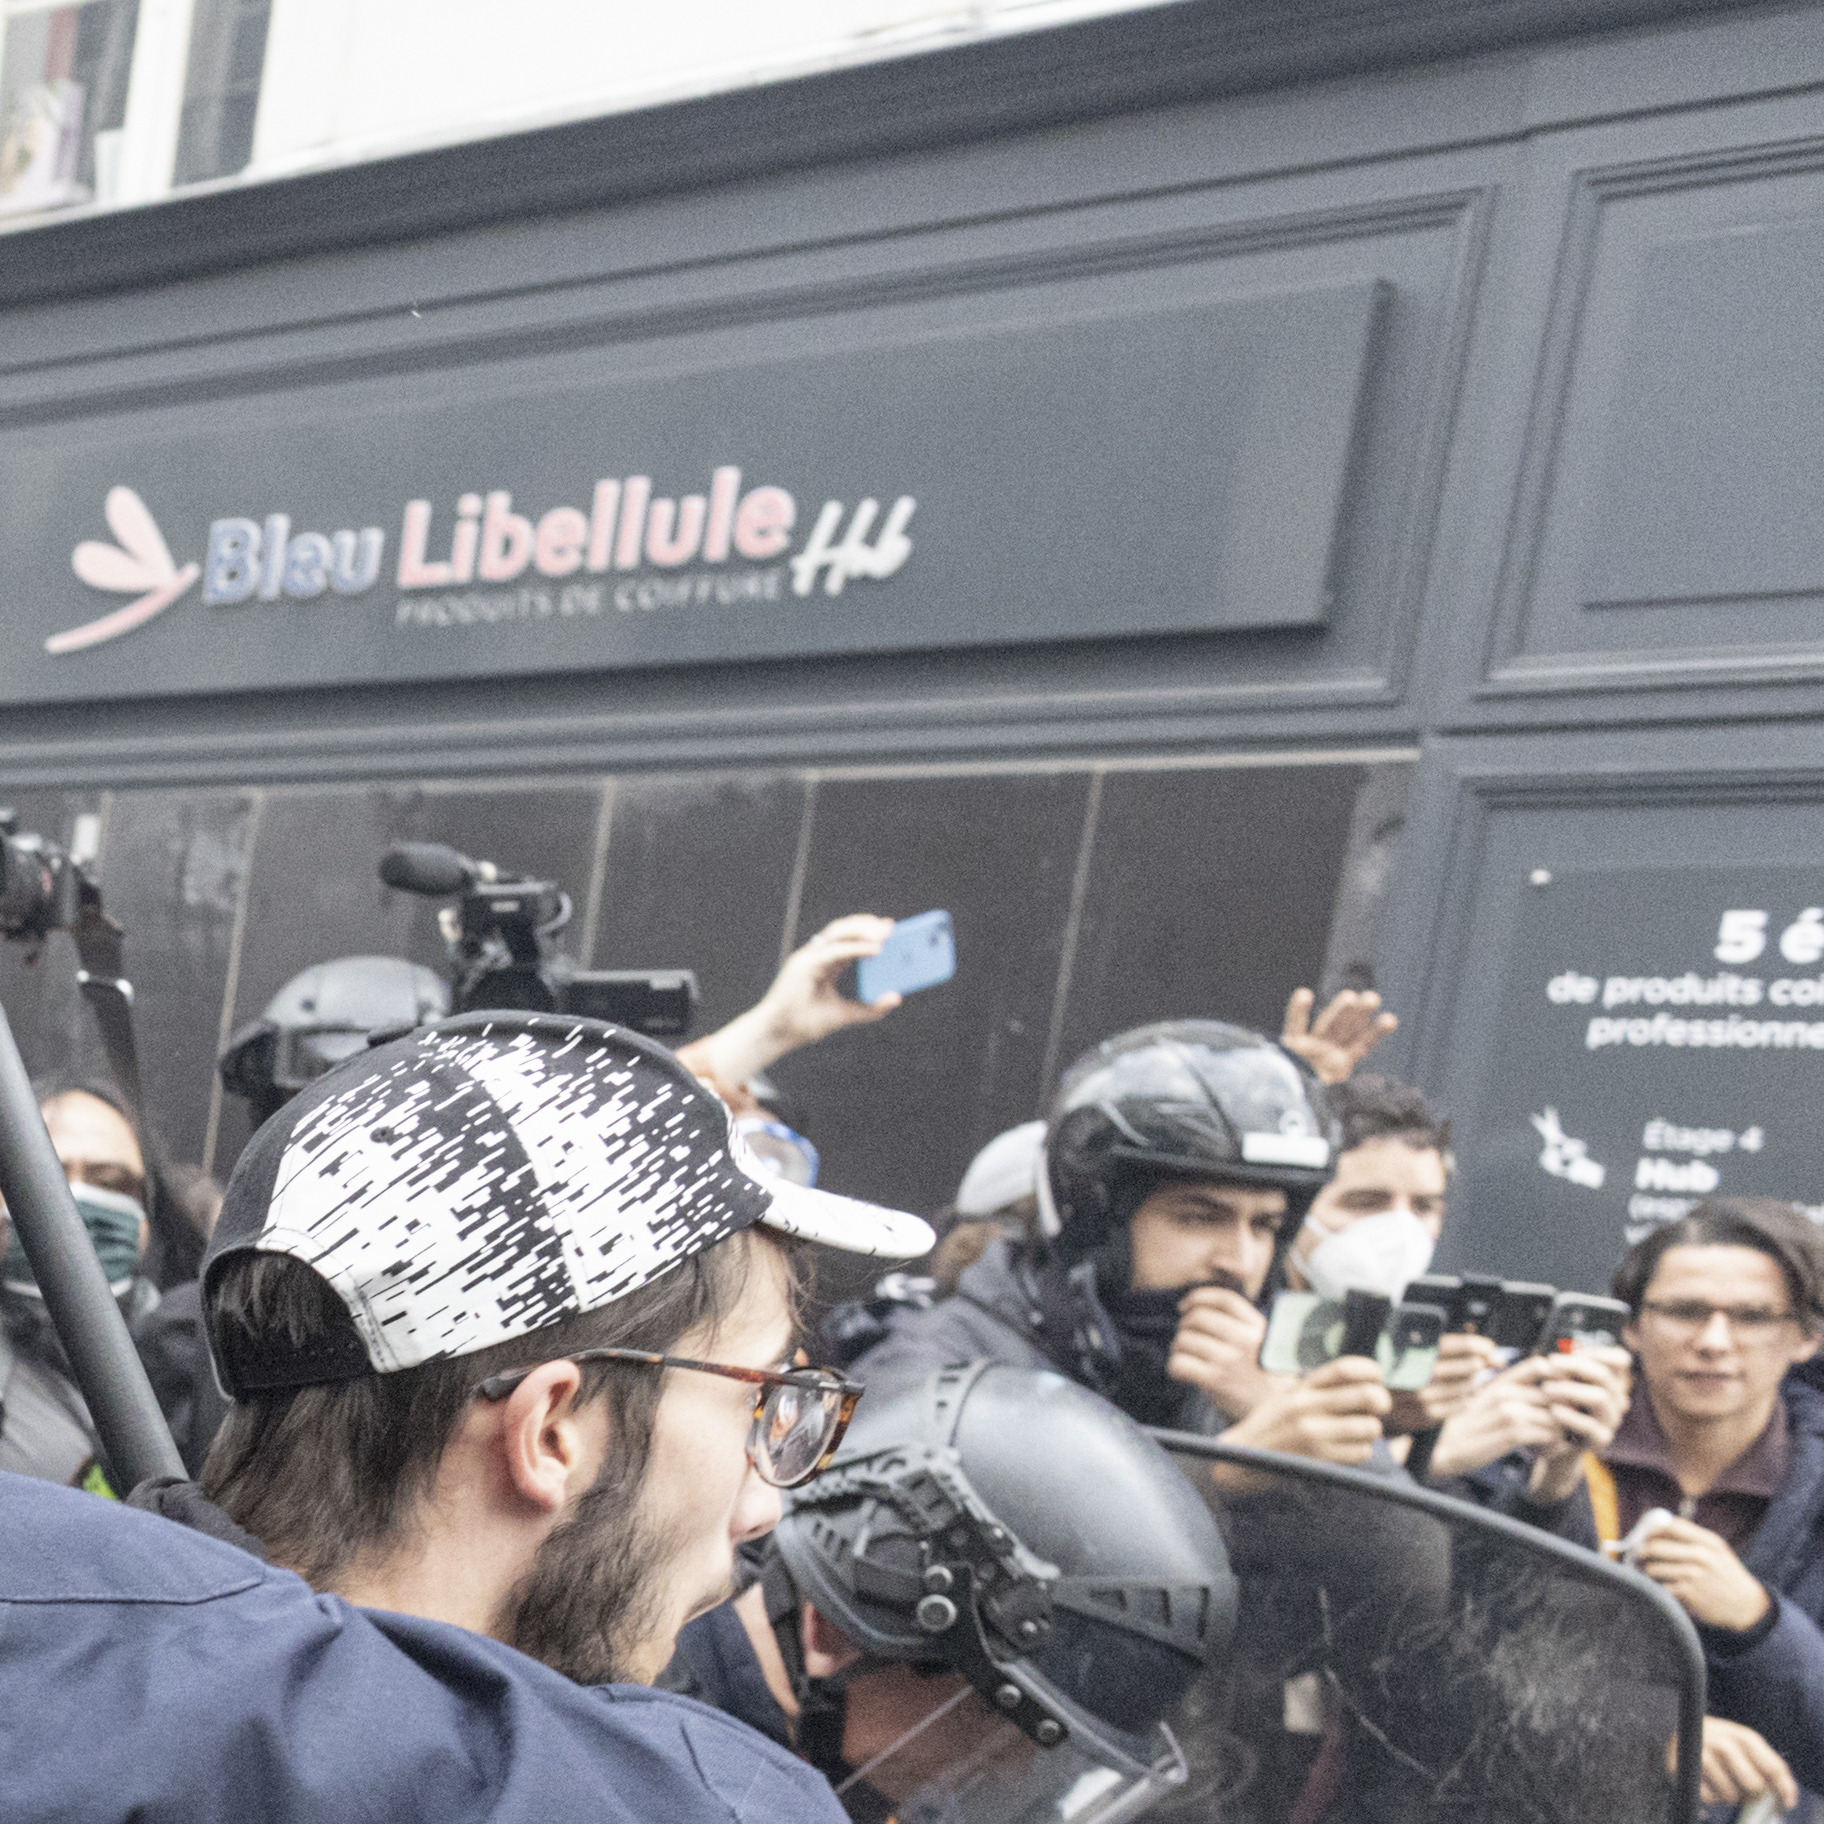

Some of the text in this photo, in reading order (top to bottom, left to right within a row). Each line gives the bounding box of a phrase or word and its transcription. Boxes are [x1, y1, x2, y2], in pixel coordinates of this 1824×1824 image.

[204, 513, 384, 604] Bleu
[397, 465, 795, 588] Libellule
[1714, 909, 1768, 964] 5
[1547, 971, 1599, 1004] de
[1603, 971, 1762, 1010] produits
[1635, 1157, 1720, 1193] Hub
